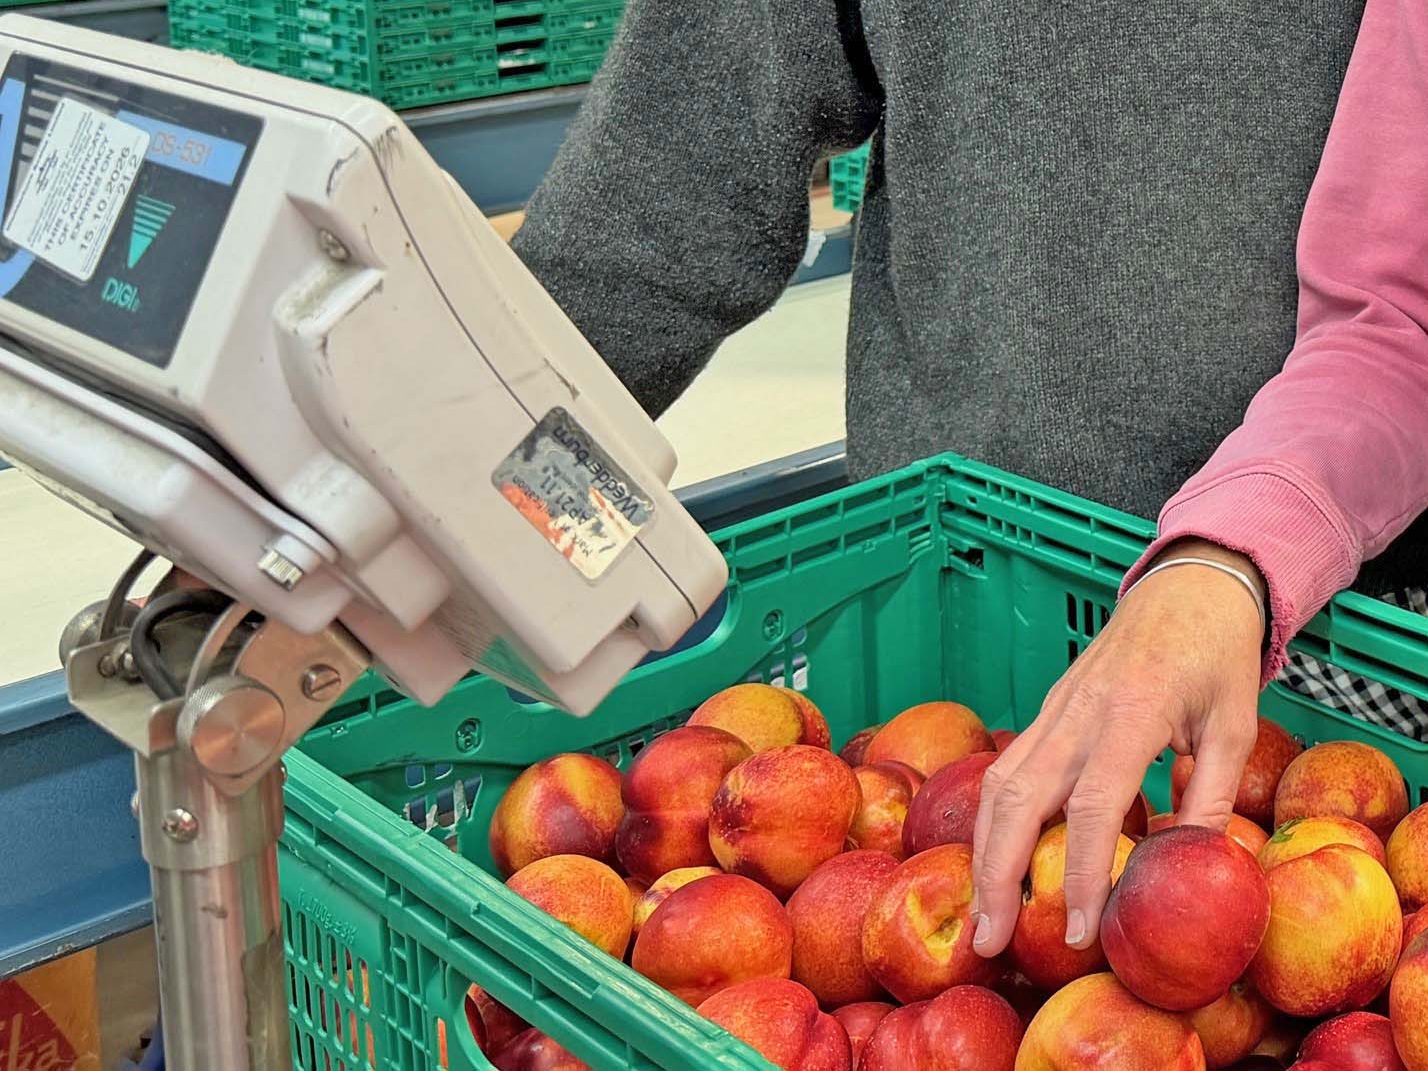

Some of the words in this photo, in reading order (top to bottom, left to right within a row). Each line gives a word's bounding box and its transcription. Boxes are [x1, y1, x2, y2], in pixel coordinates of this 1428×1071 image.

[58, 224, 70, 246] OF
[69, 136, 108, 221] ACCURACY
[62, 121, 106, 215] CERTIFICATE
[70, 177, 101, 241] EXPIRES
[100, 148, 115, 173] ON
[553, 427, 639, 521] Wedderburn
